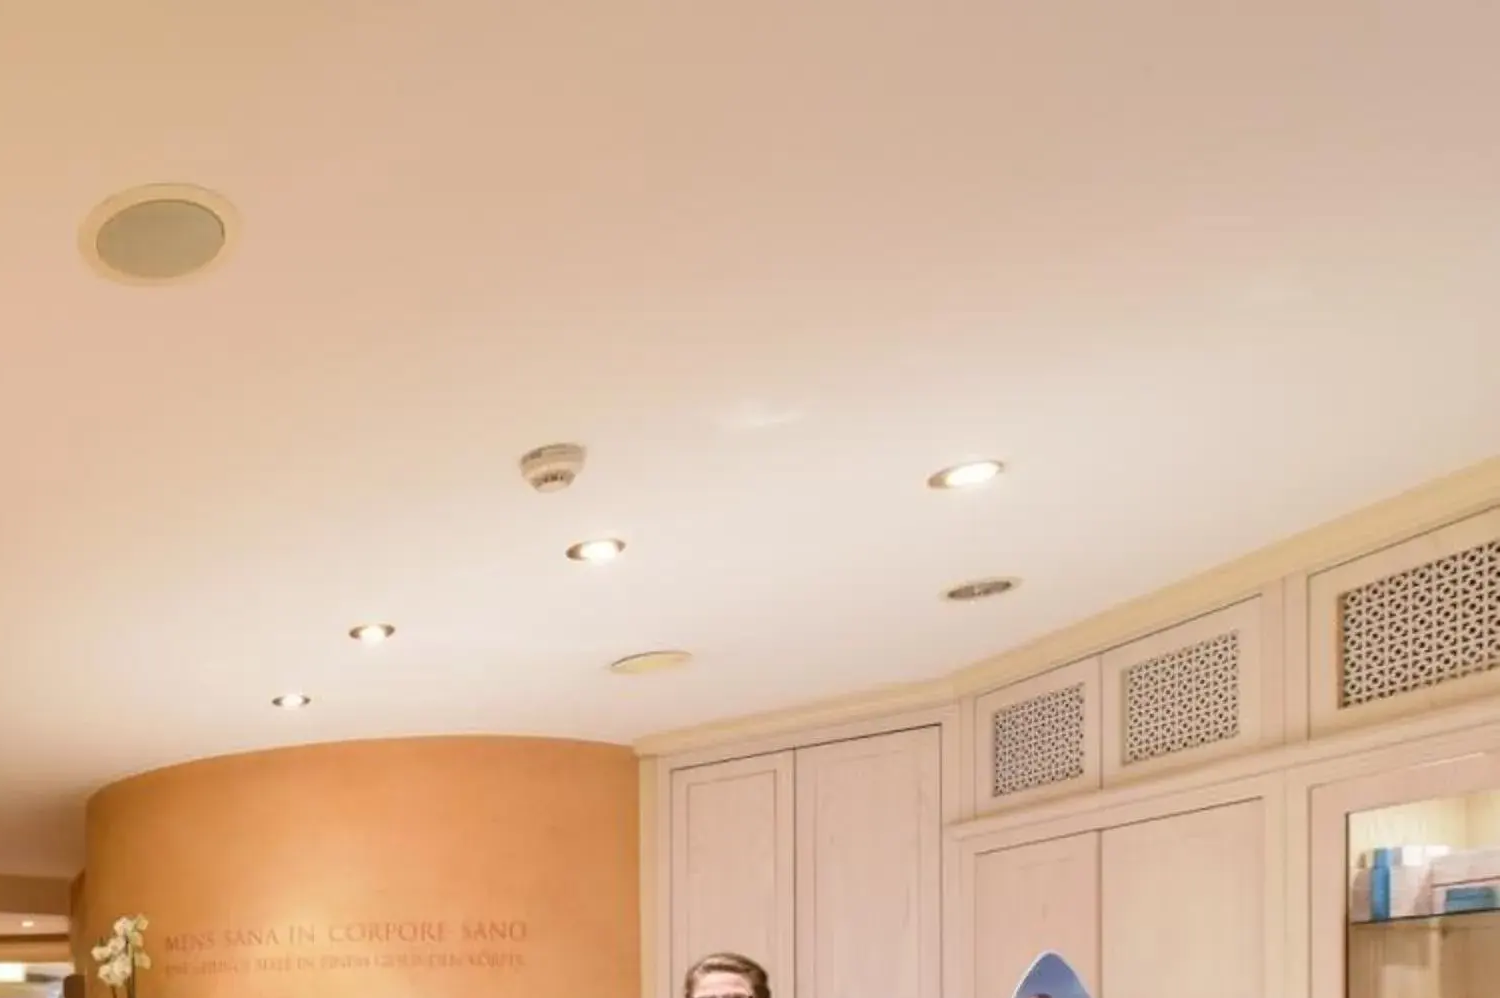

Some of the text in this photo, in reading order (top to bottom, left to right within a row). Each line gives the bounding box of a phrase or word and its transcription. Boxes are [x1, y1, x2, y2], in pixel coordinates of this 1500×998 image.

[164, 919, 528, 952] MENS SANA IN CORPORE SANO
